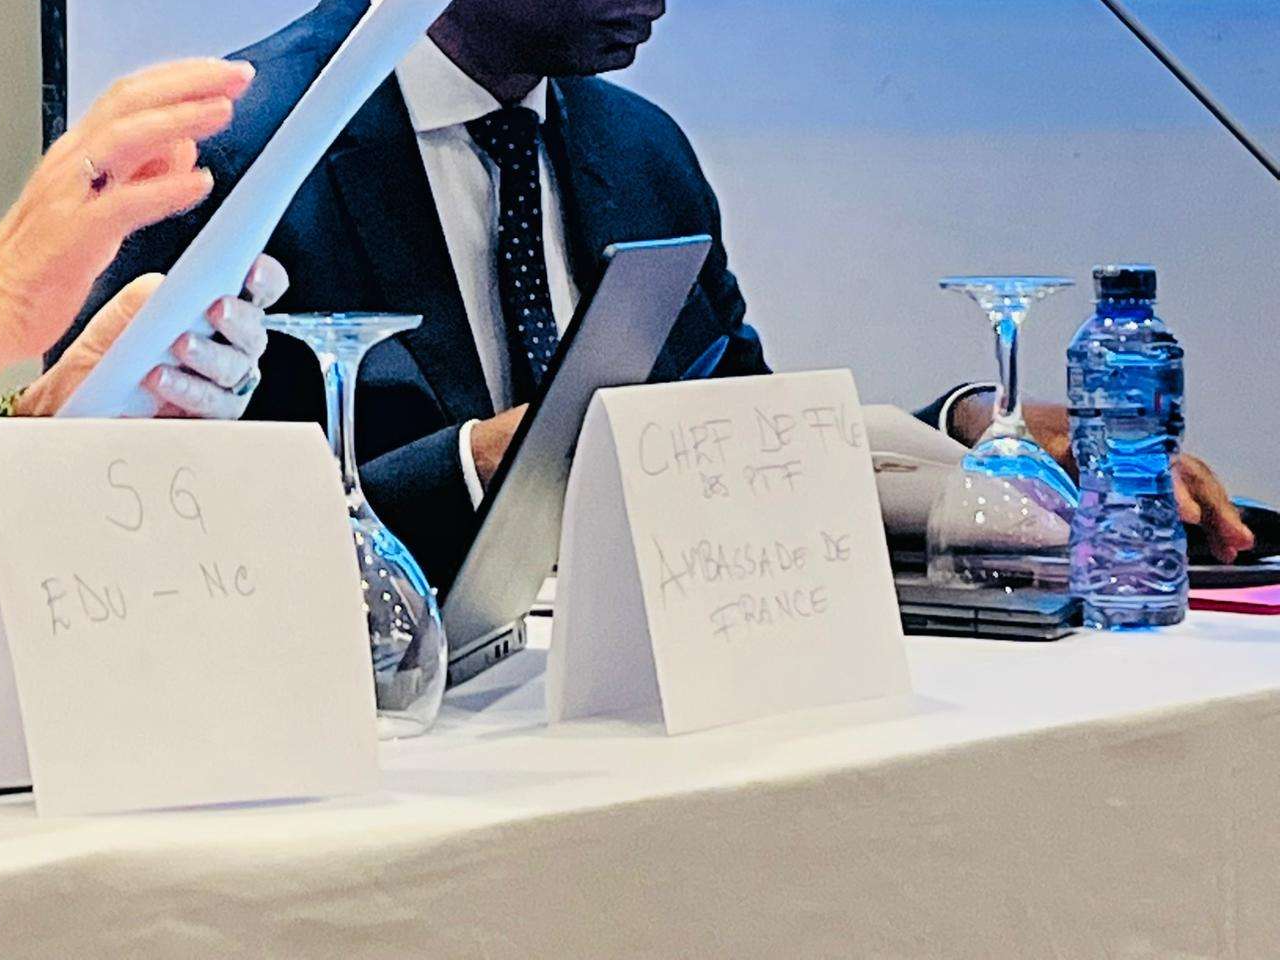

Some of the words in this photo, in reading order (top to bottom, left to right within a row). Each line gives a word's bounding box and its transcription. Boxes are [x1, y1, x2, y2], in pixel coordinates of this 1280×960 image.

[650, 534, 809, 611] AMBASSADE
[819, 530, 851, 562] DE
[708, 584, 829, 643] FRANCE
